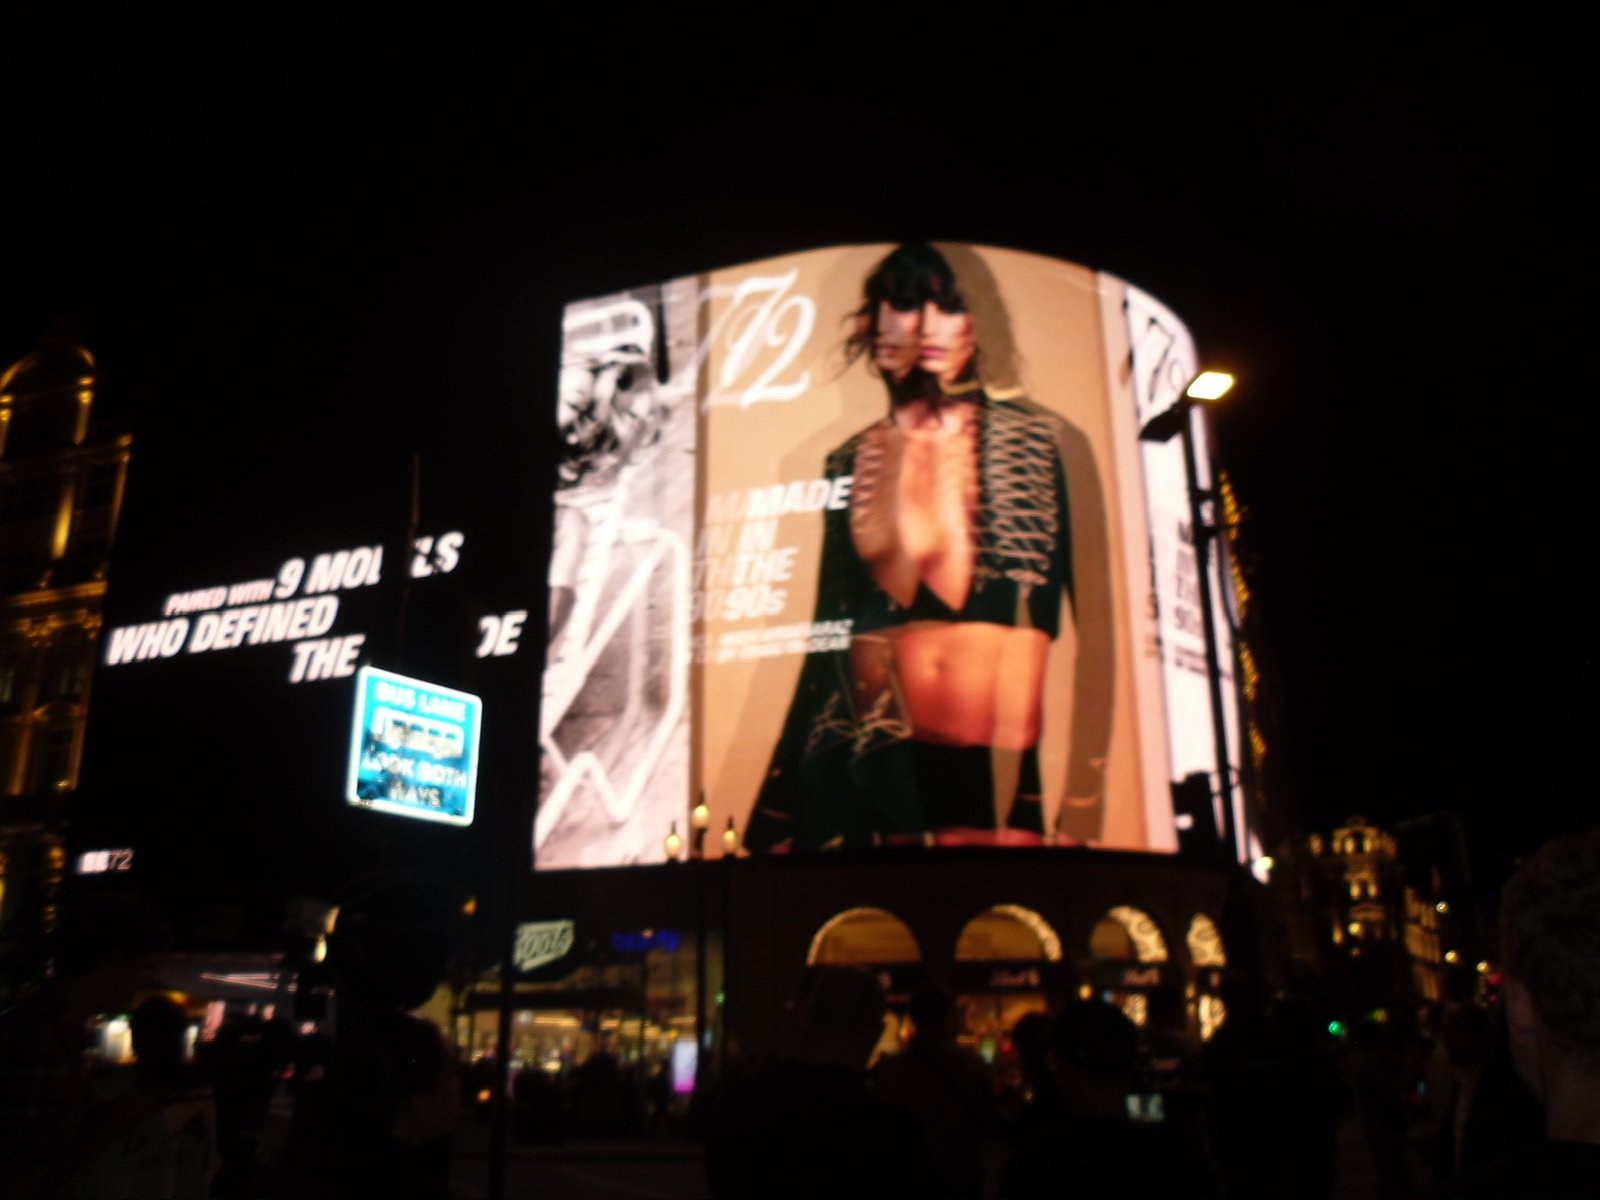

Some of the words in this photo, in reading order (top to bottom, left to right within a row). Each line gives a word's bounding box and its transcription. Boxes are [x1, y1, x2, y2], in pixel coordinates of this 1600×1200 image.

[718, 268, 816, 411] 72
[747, 476, 854, 518] MADE
[163, 586, 228, 617] PAIRED
[227, 578, 277, 606] WITH
[274, 557, 306, 600] 9
[733, 547, 799, 588] THE
[105, 617, 190, 666] WHO
[188, 594, 340, 654] DEFINED
[287, 633, 367, 684] THE
[374, 681, 416, 709] BUS
[418, 692, 467, 723] LANE
[415, 759, 469, 788] BOTH
[388, 782, 442, 808] WAYS
